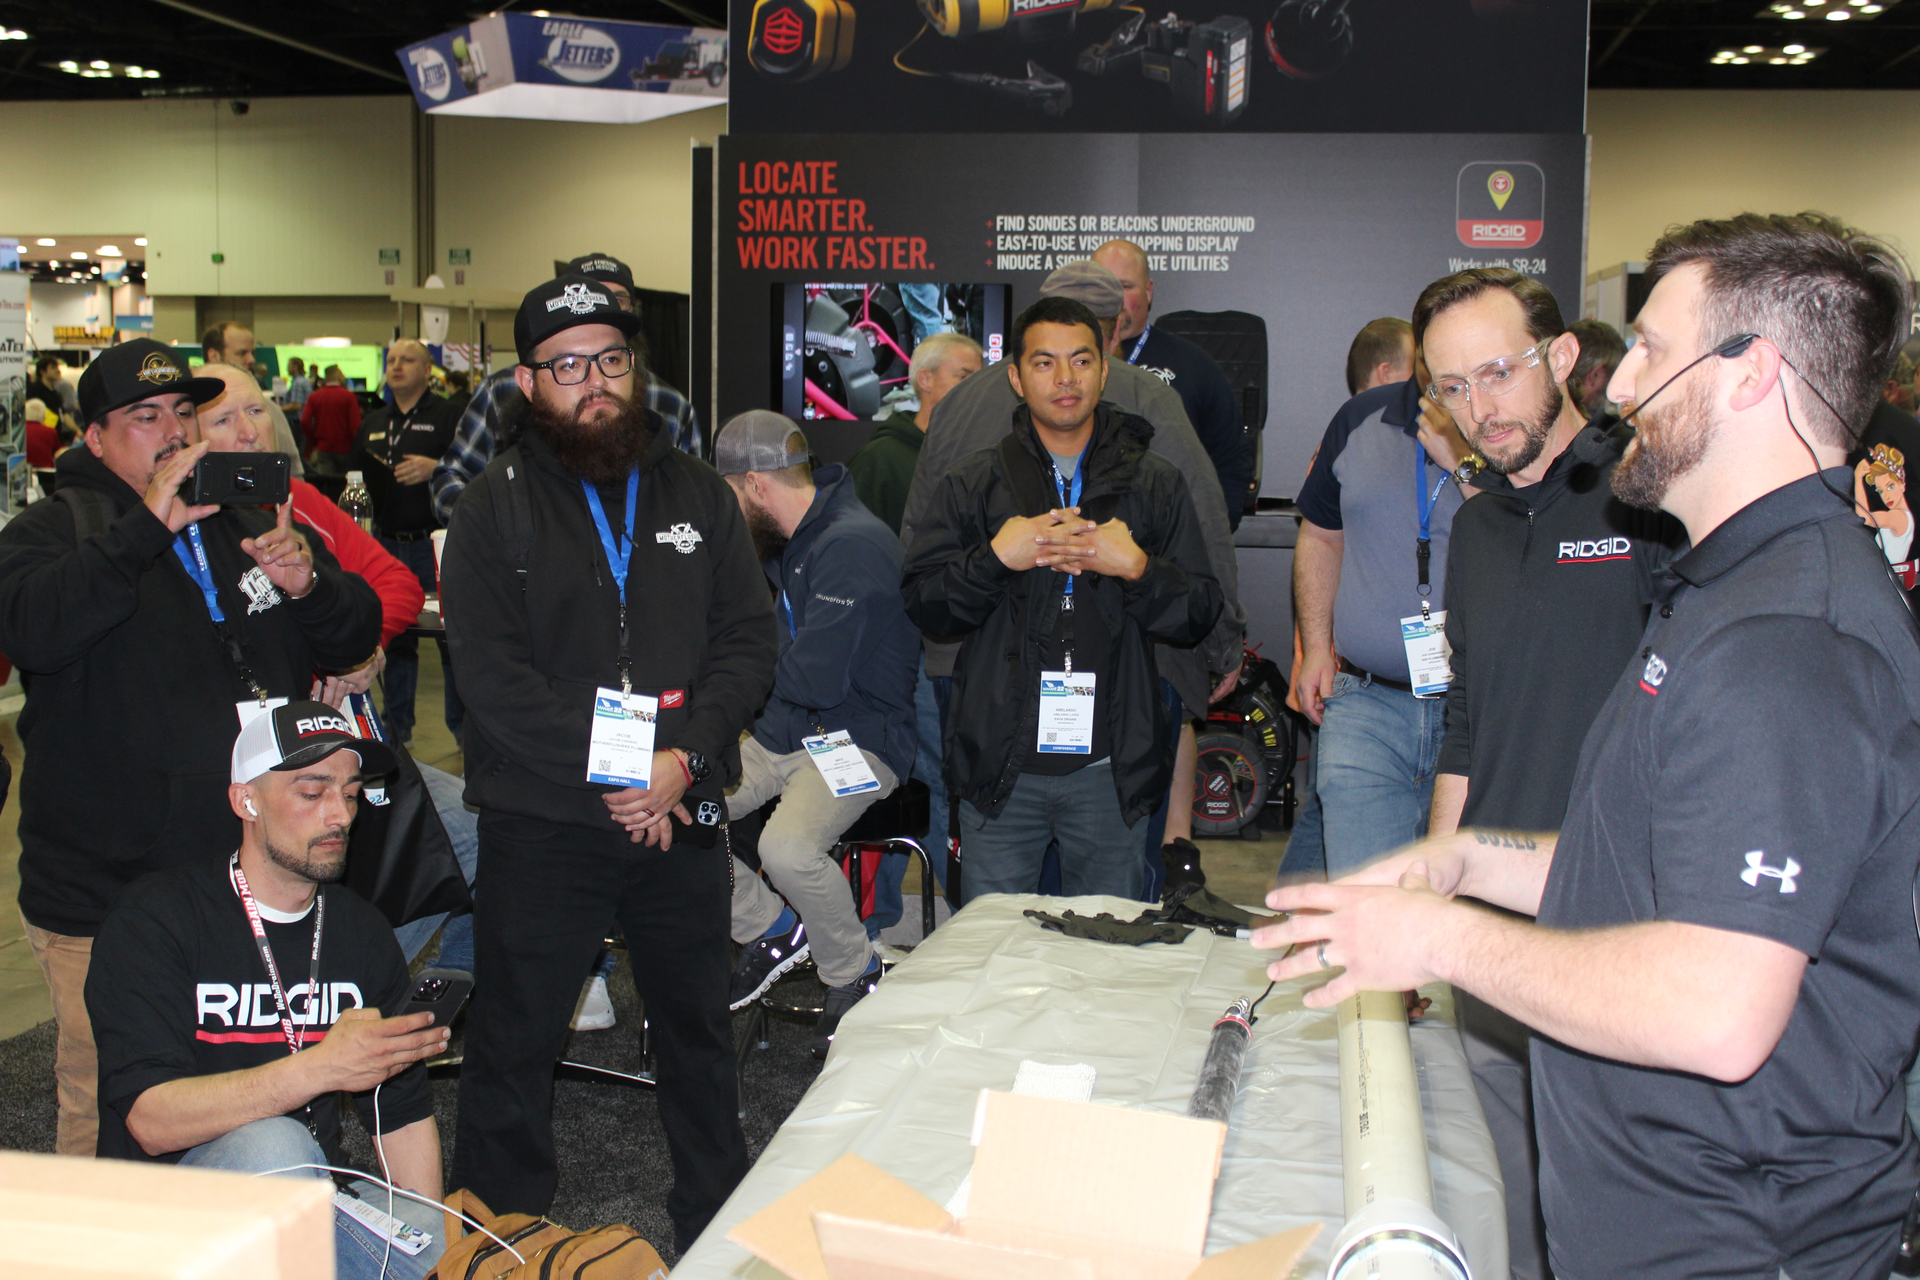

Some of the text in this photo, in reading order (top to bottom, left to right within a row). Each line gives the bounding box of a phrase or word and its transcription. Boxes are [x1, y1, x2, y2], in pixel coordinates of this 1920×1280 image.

[542, 22, 584, 39] EAGLE
[554, 40, 616, 67] JETTERS
[420, 62, 447, 86] JETTERS
[739, 161, 838, 194] LOCATE
[738, 199, 874, 232] SMARTER.
[996, 216, 1255, 232] FIND SONDES OR BEACONS UNDERGROUND
[1472, 224, 1526, 237] RIDGID
[737, 236, 935, 269] WORK FASTER.
[997, 235, 1076, 251] EASY-TO-USE
[1186, 236, 1239, 252] DISPLAY
[997, 255, 1042, 270] INDUCE
[1044, 255, 1053, 270] A
[1171, 256, 1229, 271] UTILITIES
[1448, 258, 1482, 272] Works
[1512, 258, 1547, 274] SR-24
[1558, 537, 1631, 559] RIDGID
[234, 869, 266, 937] DRAIN MOB
[312, 895, 323, 961] WeDoDrains.com
[262, 946, 286, 1011] WeDoDrains.com
[196, 982, 364, 1027] RIDGID
